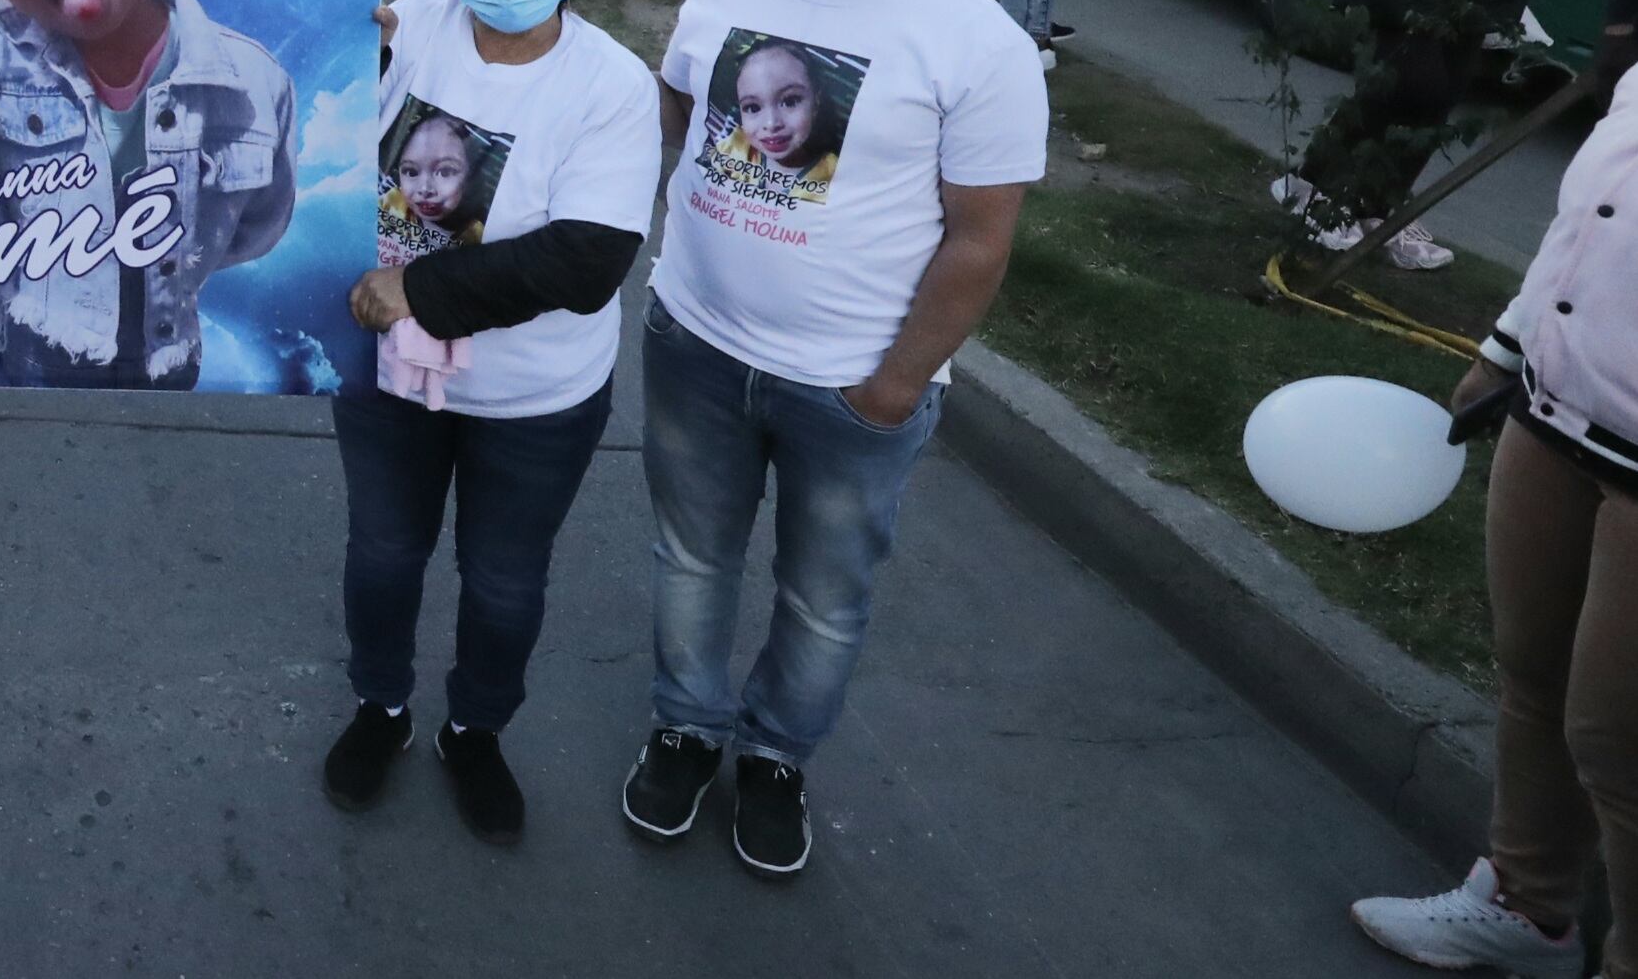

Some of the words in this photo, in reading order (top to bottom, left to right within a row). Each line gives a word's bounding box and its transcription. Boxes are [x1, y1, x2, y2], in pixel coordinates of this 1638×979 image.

[703, 167, 728, 188] POR
[730, 181, 800, 211] SIEMPRE
[712, 153, 828, 194] RECORDAREMOS
[706, 187, 731, 205] IVANA
[377, 208, 465, 247] ECORDAREM
[377, 222, 393, 239] OR
[690, 191, 736, 228] RANGEL
[744, 218, 808, 247] MOLINA
[377, 238, 400, 254] VANA
